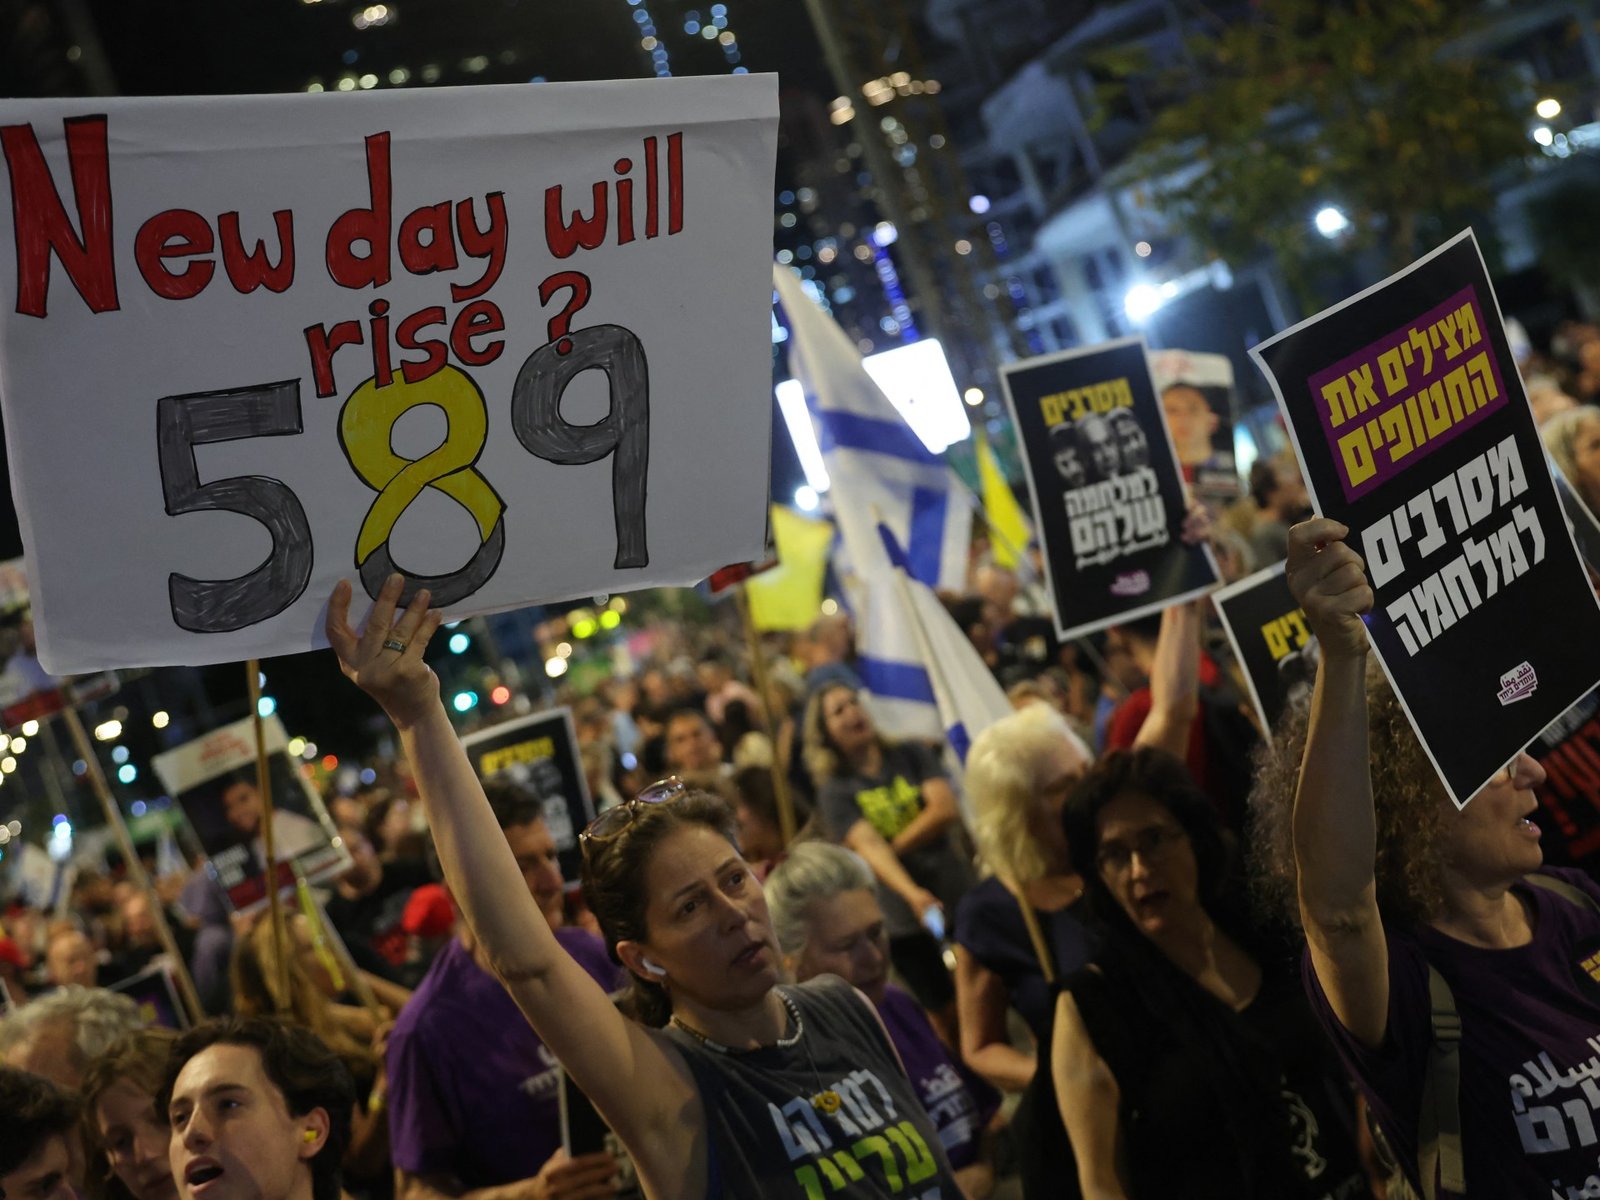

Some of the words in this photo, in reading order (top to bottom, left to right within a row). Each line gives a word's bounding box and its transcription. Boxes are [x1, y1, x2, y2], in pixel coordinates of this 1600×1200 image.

[1, 114, 294, 318] New
[325, 131, 508, 303] day
[544, 132, 684, 259] will
[304, 299, 505, 398] rise
[1321, 362, 1381, 429] את
[1337, 350, 1499, 488] החטופים
[1377, 301, 1483, 399] מצילים
[156, 323, 650, 633] 589
[1360, 434, 1530, 590] מסרבים
[1386, 505, 1546, 657] למלחמה
